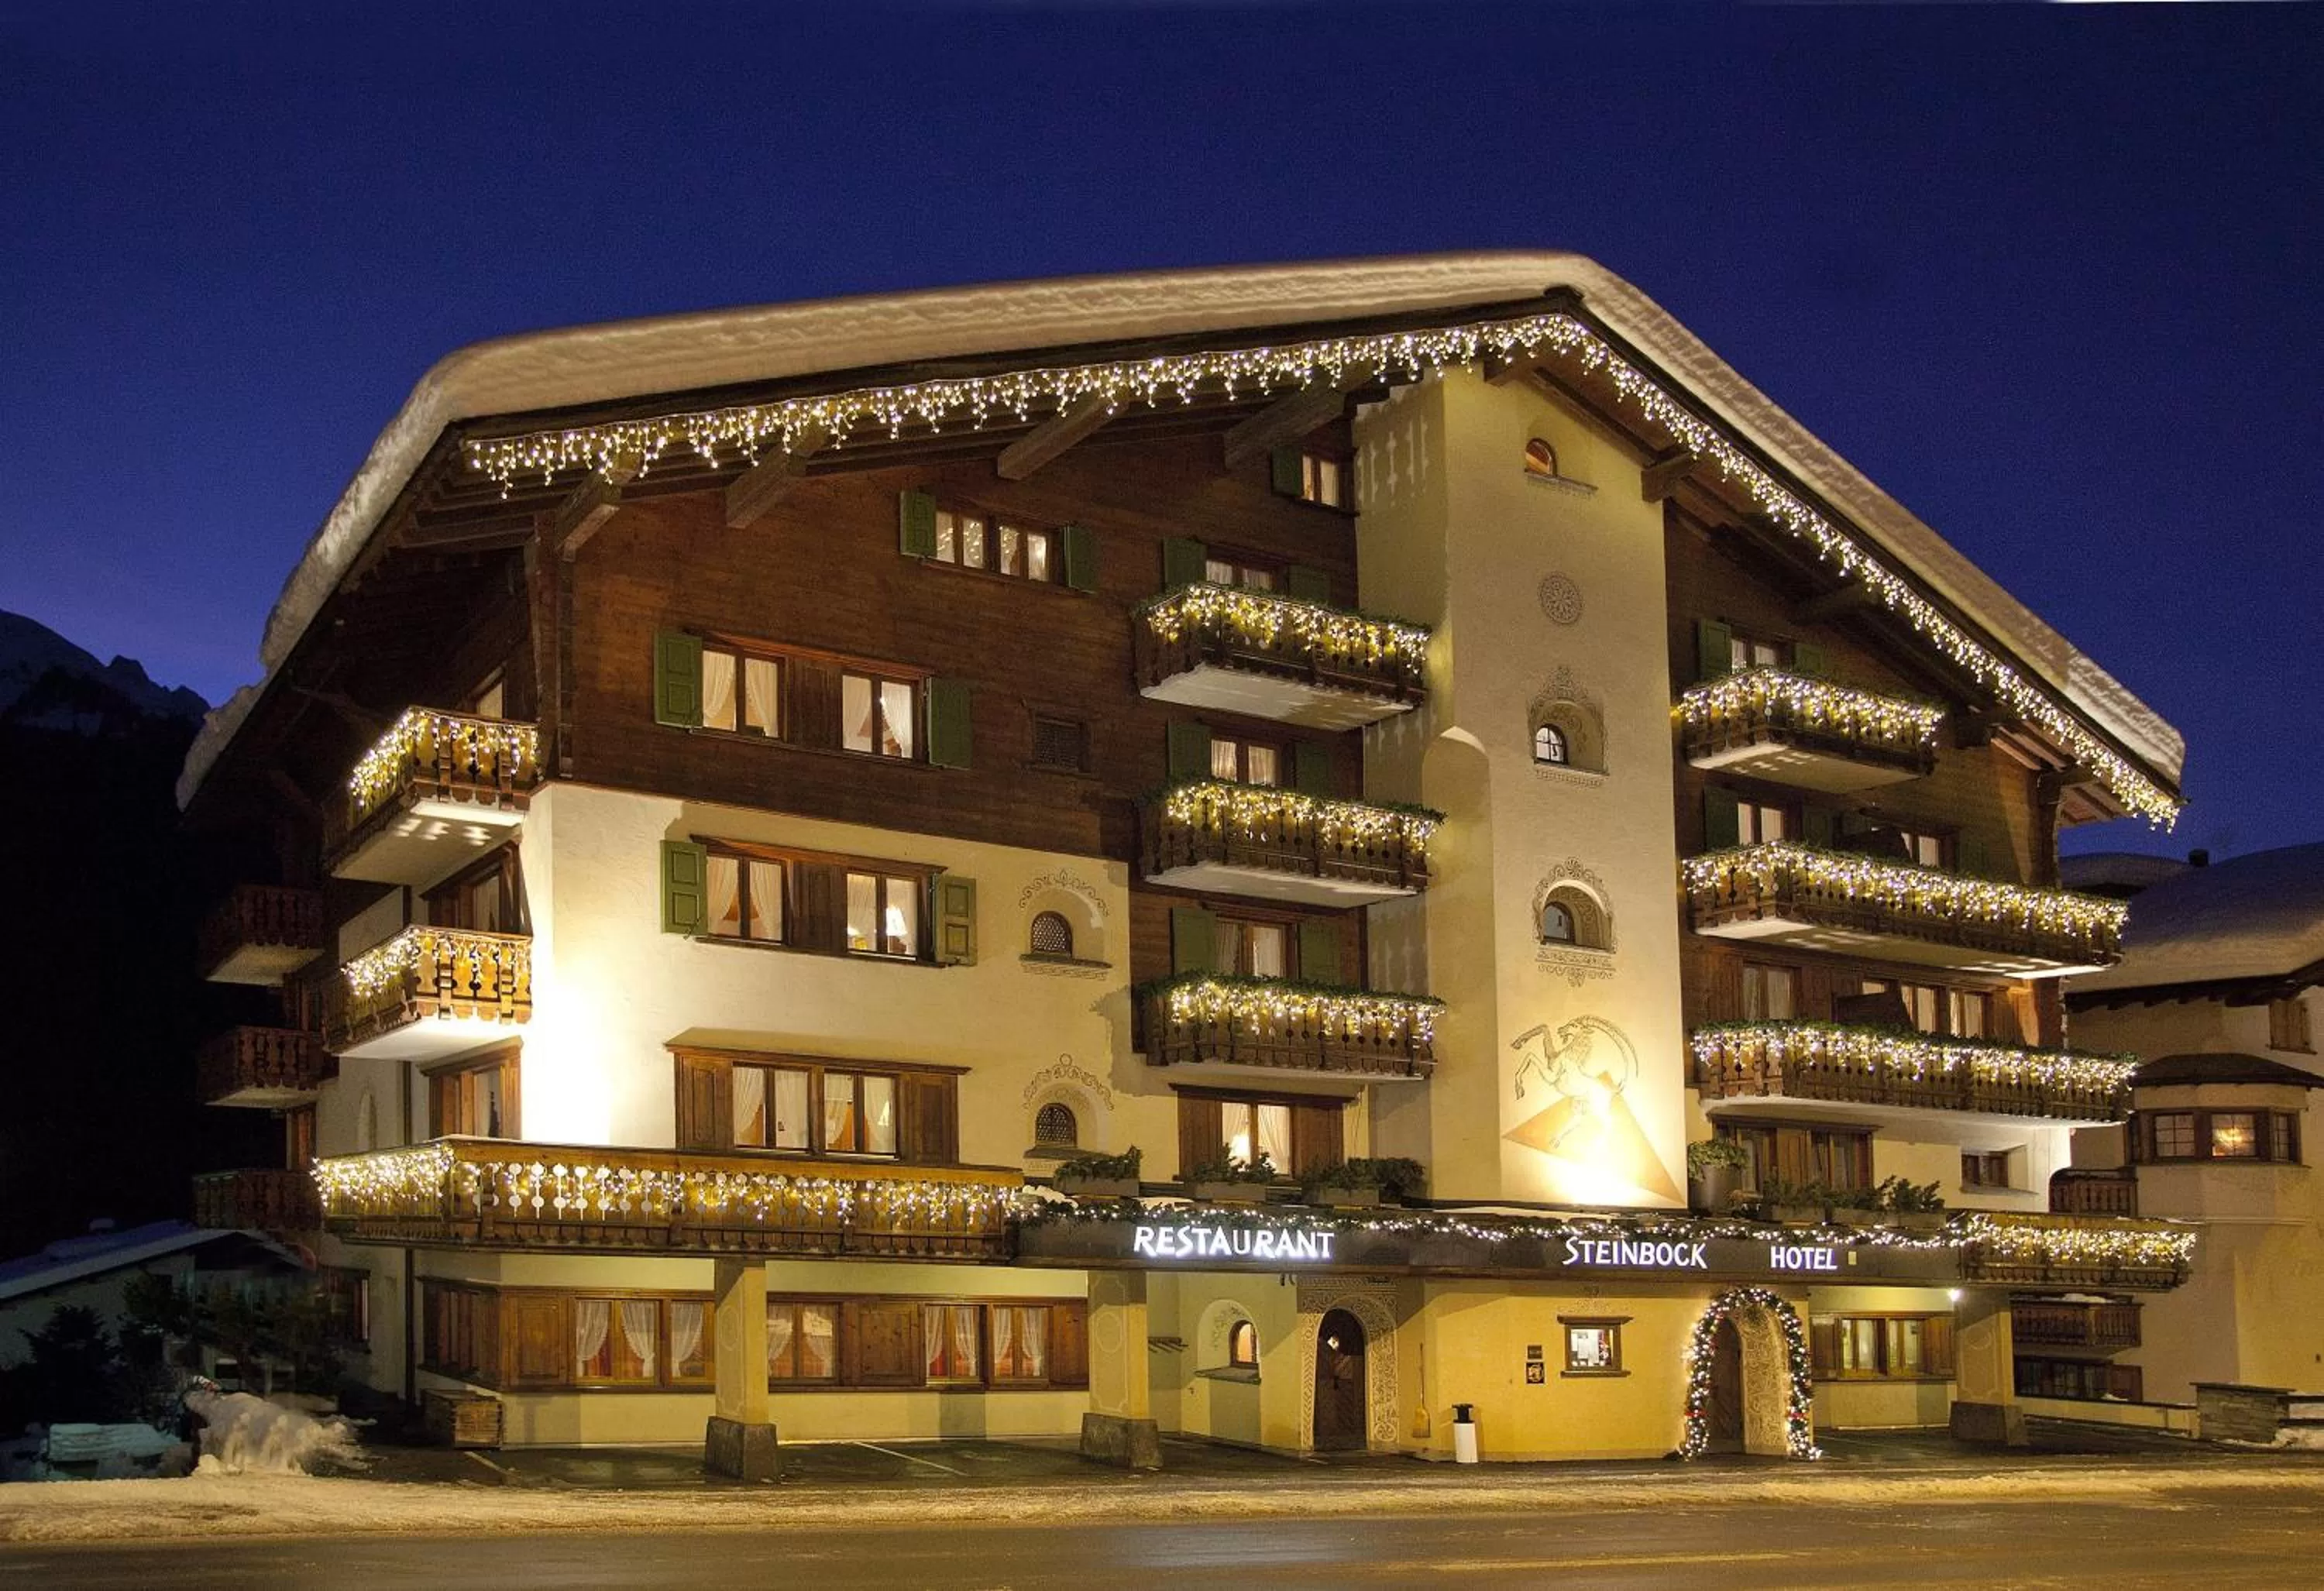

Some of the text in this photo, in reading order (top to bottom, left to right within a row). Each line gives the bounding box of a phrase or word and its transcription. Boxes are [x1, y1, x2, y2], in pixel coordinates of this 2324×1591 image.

[1133, 1225, 1335, 1259] RESTAURANT
[1562, 1236, 1838, 1270] STEINBOCK HOTEL
